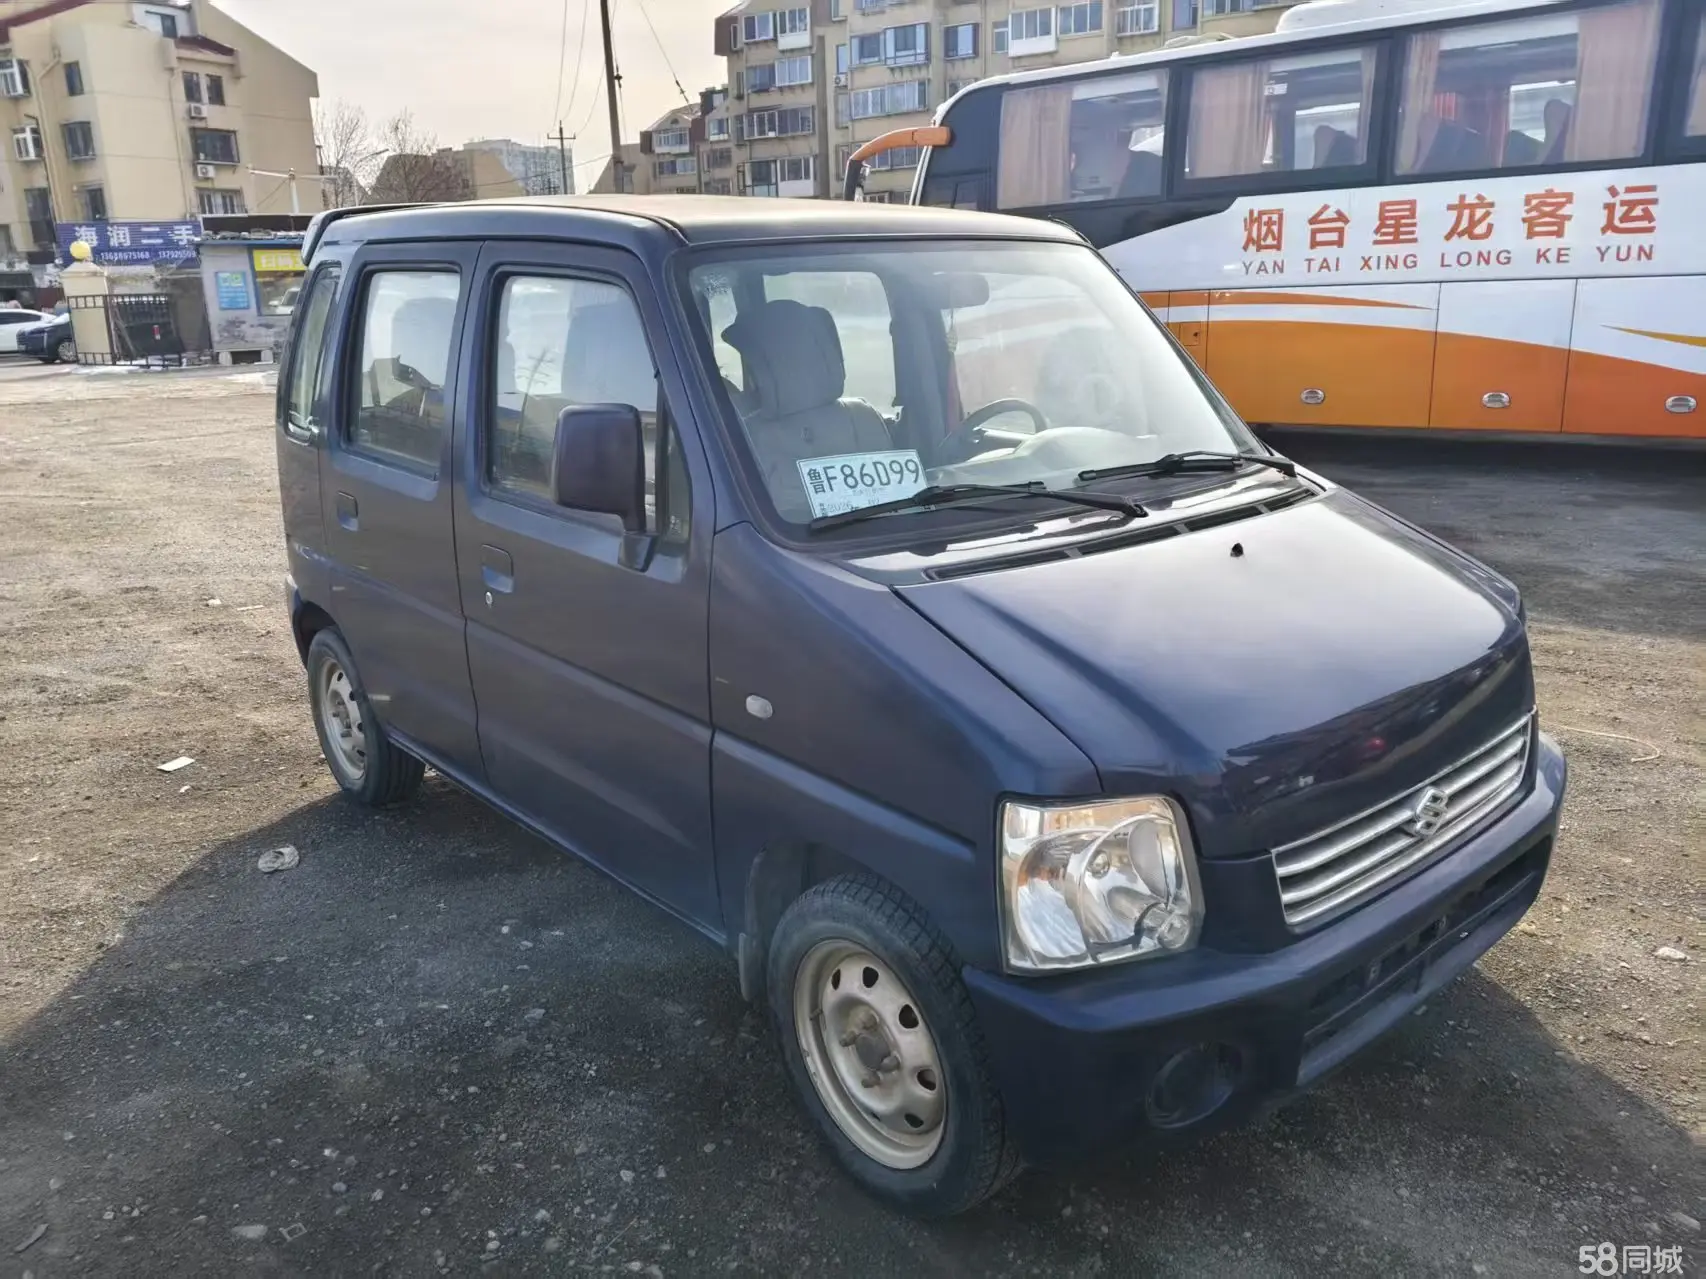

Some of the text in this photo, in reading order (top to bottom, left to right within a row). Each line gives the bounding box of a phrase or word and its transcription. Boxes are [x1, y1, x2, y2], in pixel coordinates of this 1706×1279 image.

[1242, 184, 1659, 253] 烟台星龙客运
[74, 225, 193, 247] 海润二手
[1242, 244, 1654, 275] YAN TAI XING LONG KE YUN
[807, 459, 920, 494] 鲁F86D99
